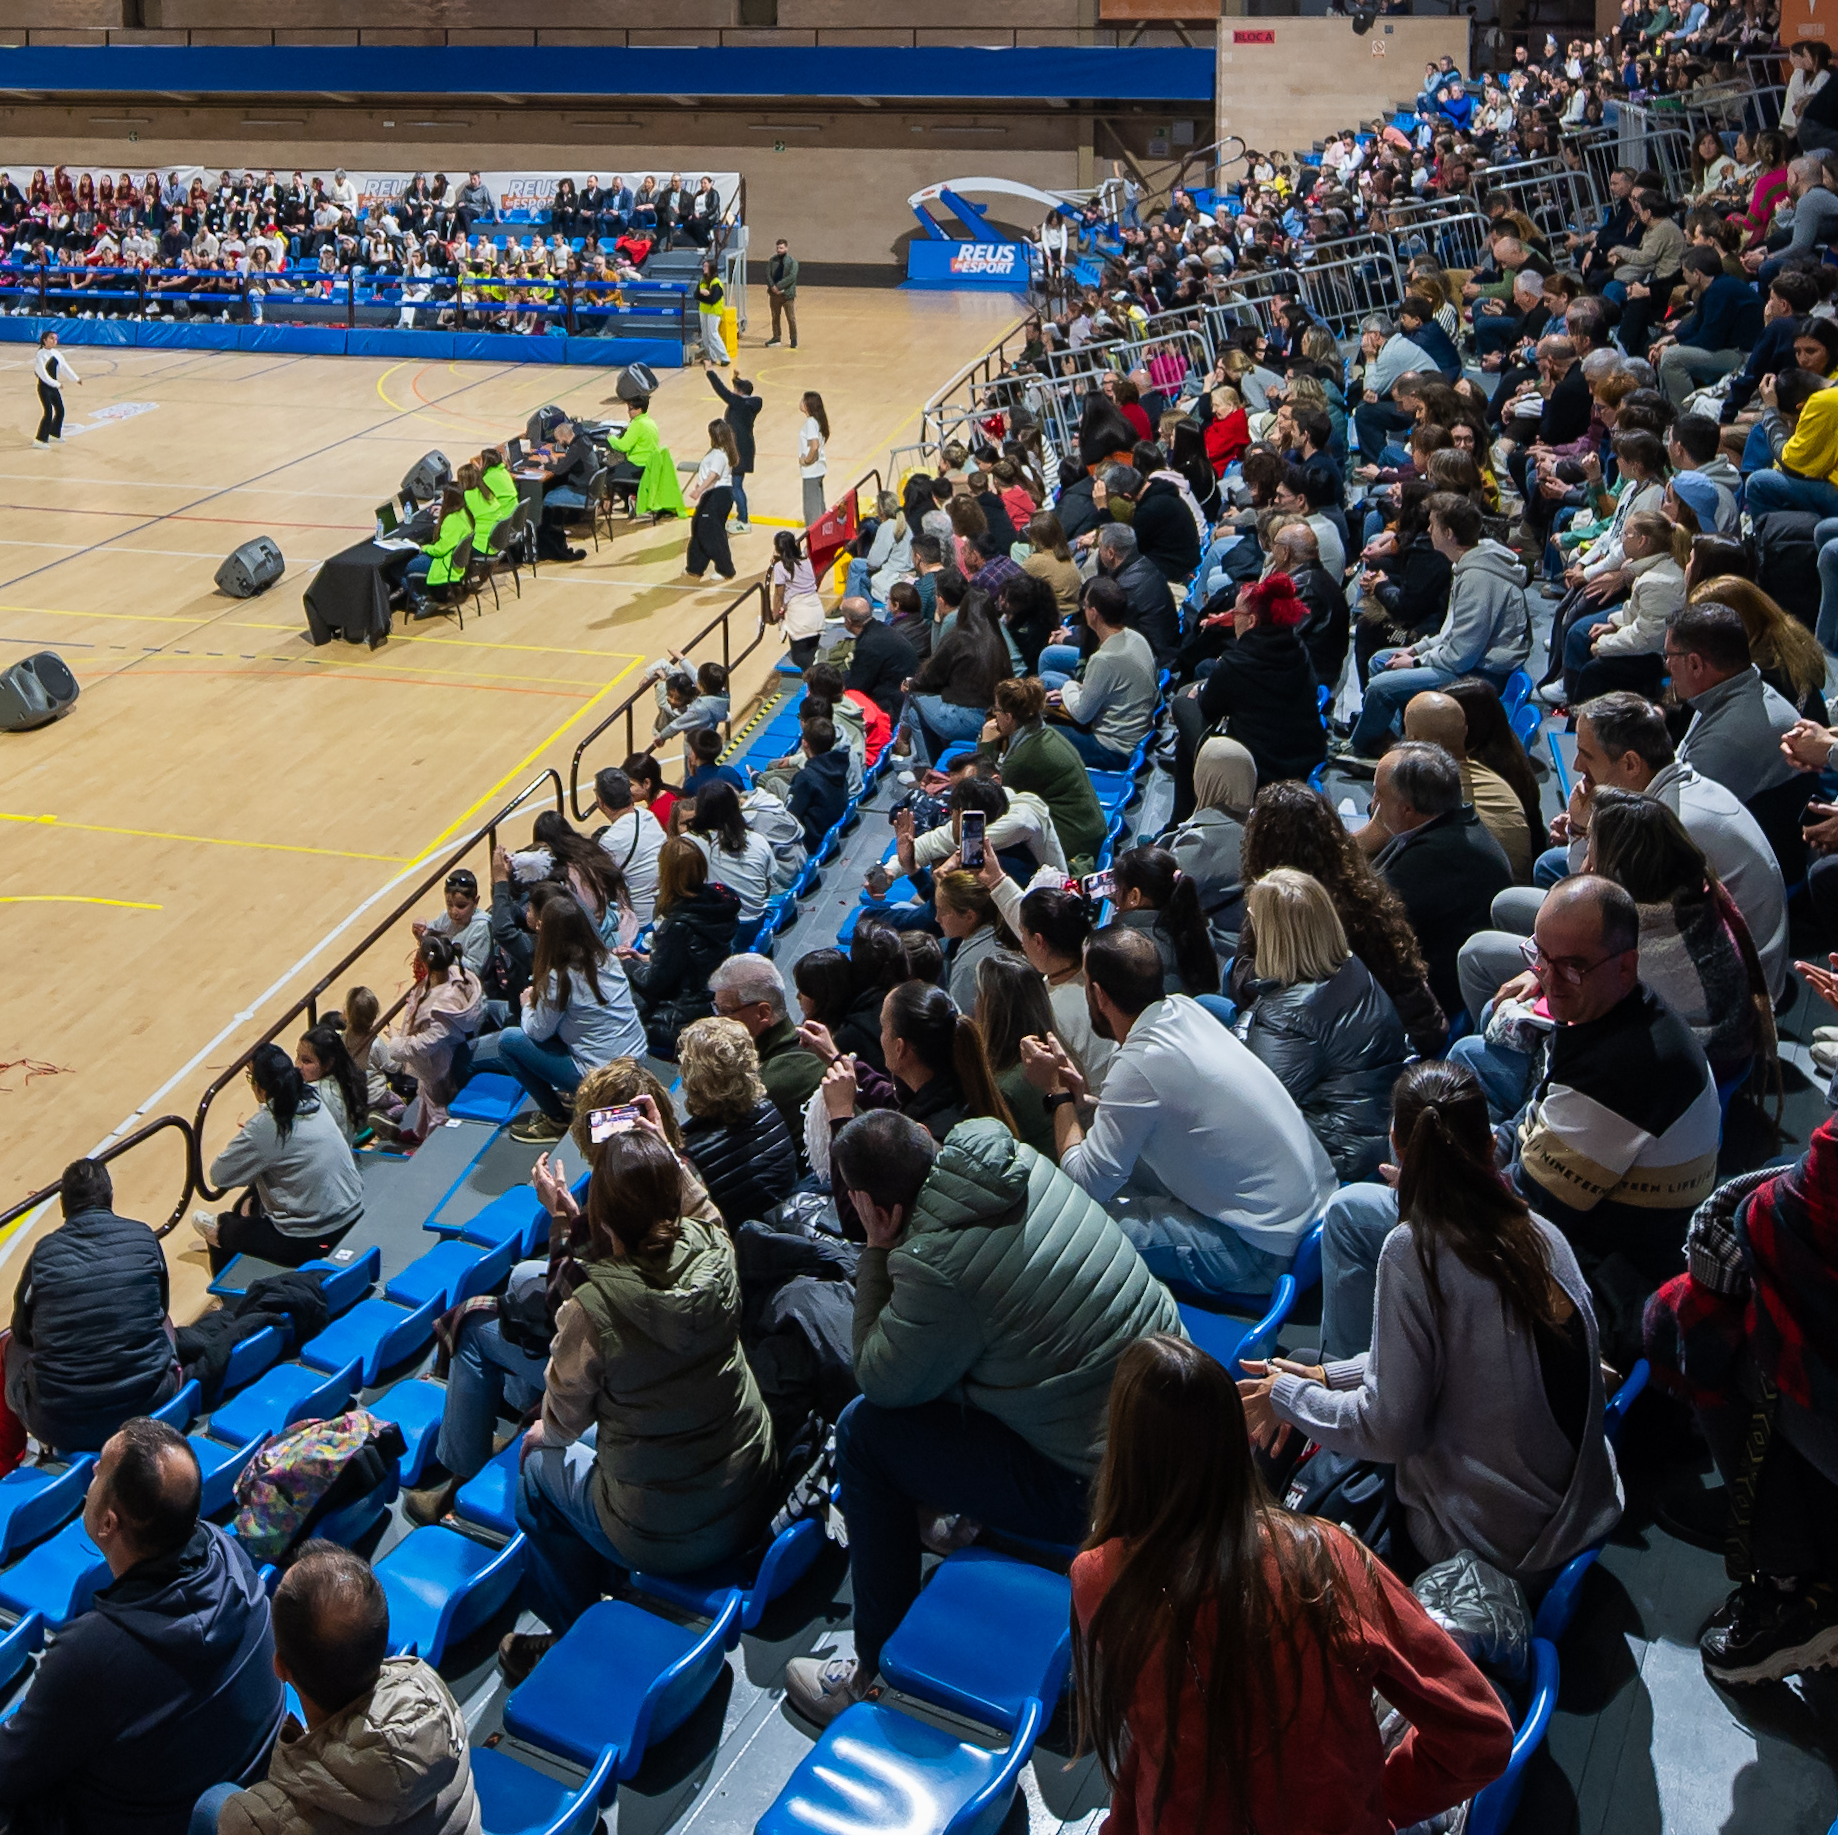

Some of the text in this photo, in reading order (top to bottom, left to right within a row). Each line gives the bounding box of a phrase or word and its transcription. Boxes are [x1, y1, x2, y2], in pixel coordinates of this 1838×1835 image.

[1234, 32, 1273, 42] BLOC A
[364, 179, 412, 195] REU
[958, 244, 1015, 262] REUS
[961, 262, 1015, 274] ESPORT
